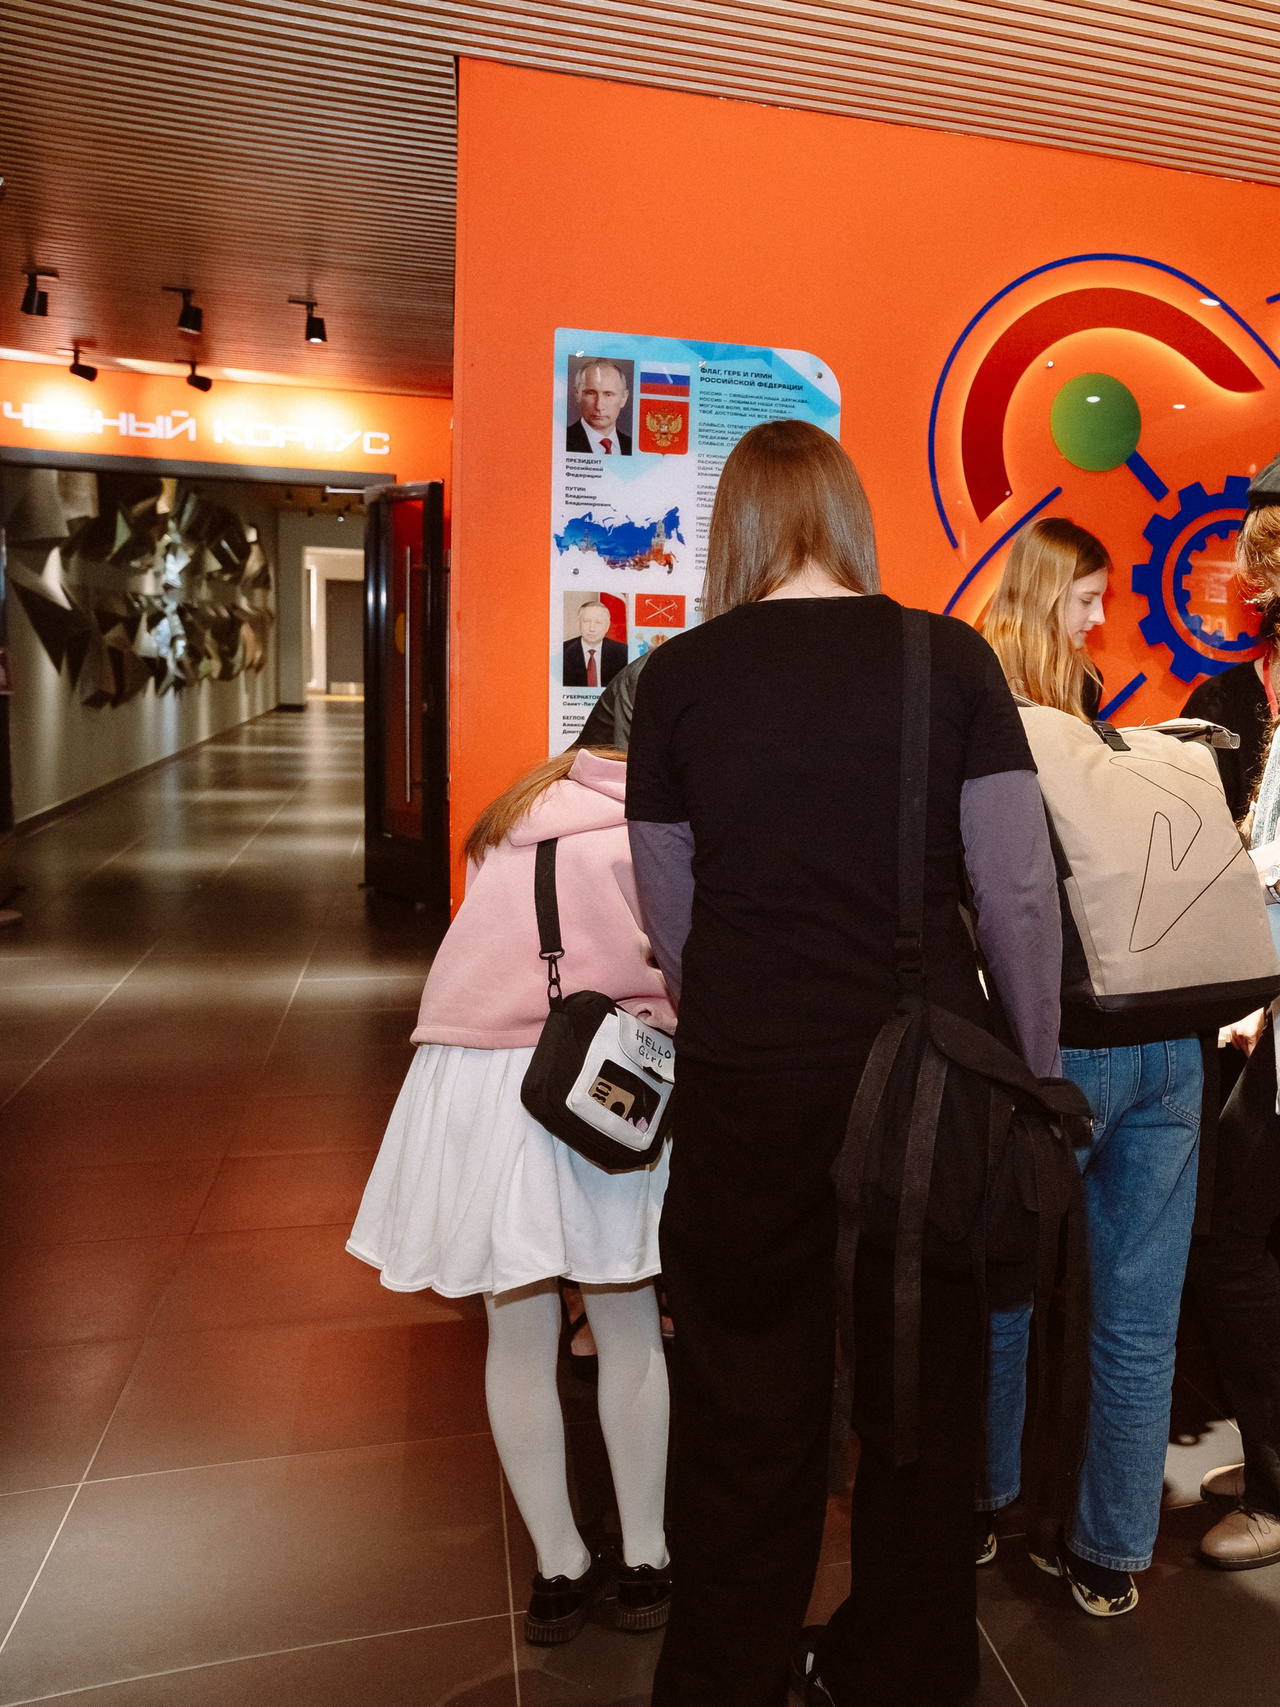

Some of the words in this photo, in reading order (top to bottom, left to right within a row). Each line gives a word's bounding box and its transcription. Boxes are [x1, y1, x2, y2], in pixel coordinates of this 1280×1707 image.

[700, 367, 722, 375] ФЛАГ,
[700, 376, 755, 386] РОССИЙСКОЙ
[757, 382, 804, 391] ФЕДЕРАЦИИ
[1, 401, 196, 442] ЧЕБНЫЙ
[213, 419, 390, 455] КОРПУС
[565, 457, 602, 465] ПРЕЗИДЕНТ
[565, 471, 602, 479] Федерации
[565, 493, 597, 501] Владимир
[564, 500, 611, 508] Владимирович
[635, 1029, 672, 1059] HELLO
[638, 1045, 663, 1068] Girl
